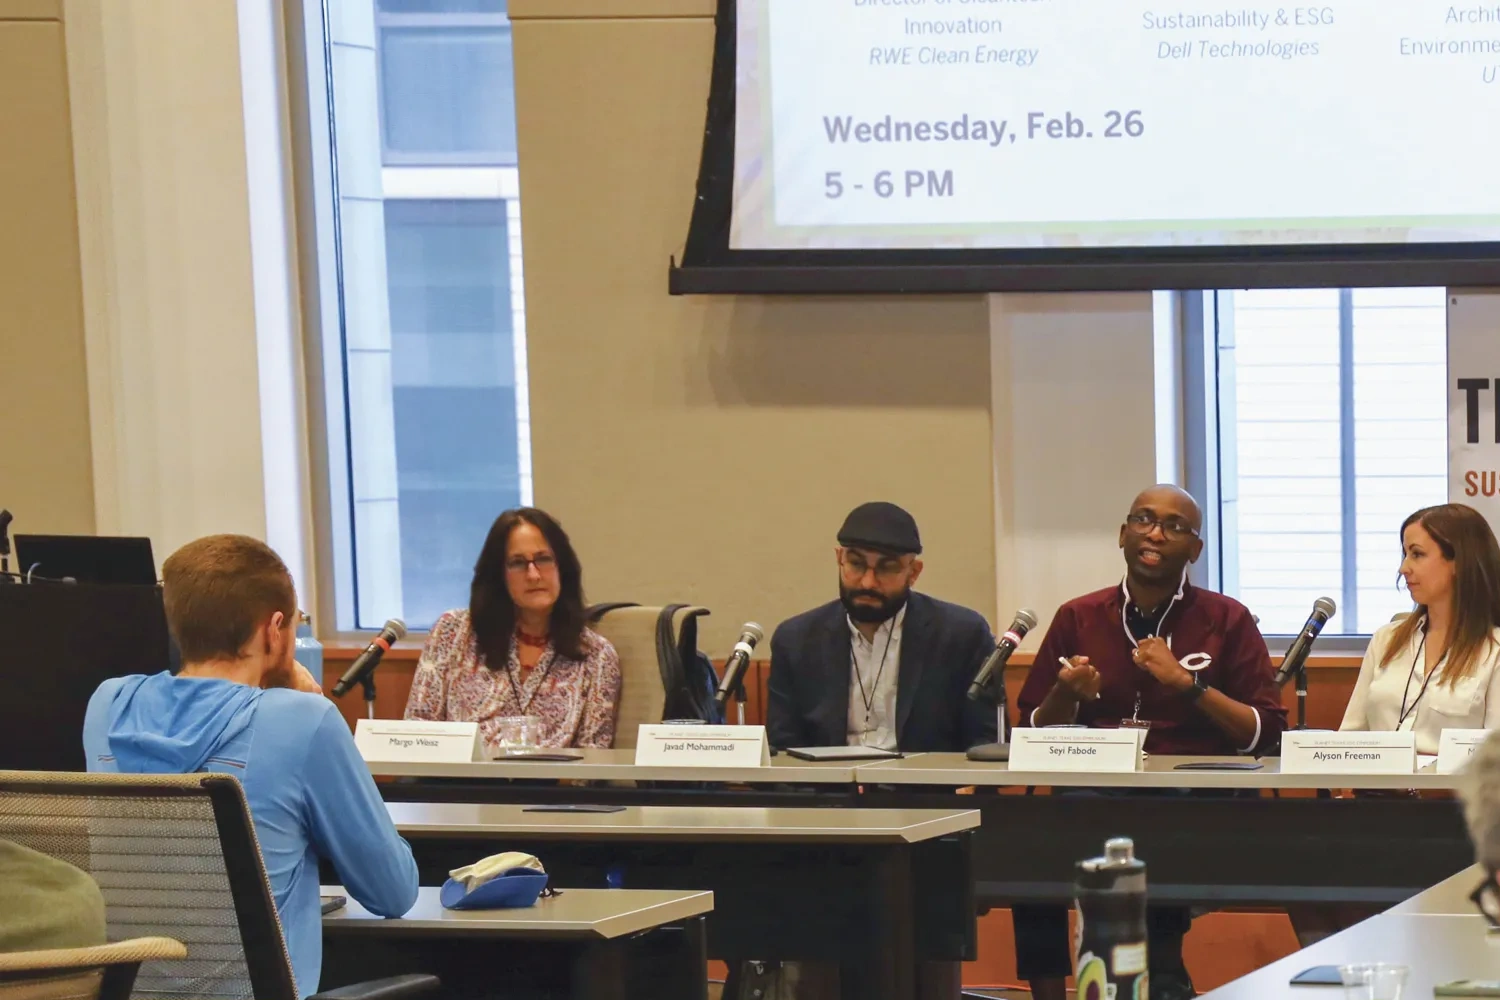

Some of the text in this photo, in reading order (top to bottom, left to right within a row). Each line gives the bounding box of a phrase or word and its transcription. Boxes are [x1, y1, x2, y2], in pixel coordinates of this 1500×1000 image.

[904, 17, 1002, 35] Innovation
[1142, 6, 1334, 32] Sustainability & ESG
[869, 44, 1039, 68] RWE Clean Energy
[1157, 39, 1319, 60] Dell Technologies
[822, 109, 1145, 147] Wednesday, Feb. 26
[825, 171, 844, 200] 5
[873, 170, 894, 199] 6
[904, 169, 954, 198] PM
[389, 737, 414, 749] Margo
[663, 742, 735, 753] Javad Mohammadi
[1049, 745, 1097, 757] Seyi Fabode
[1312, 751, 1381, 762] Alyson Freeman
